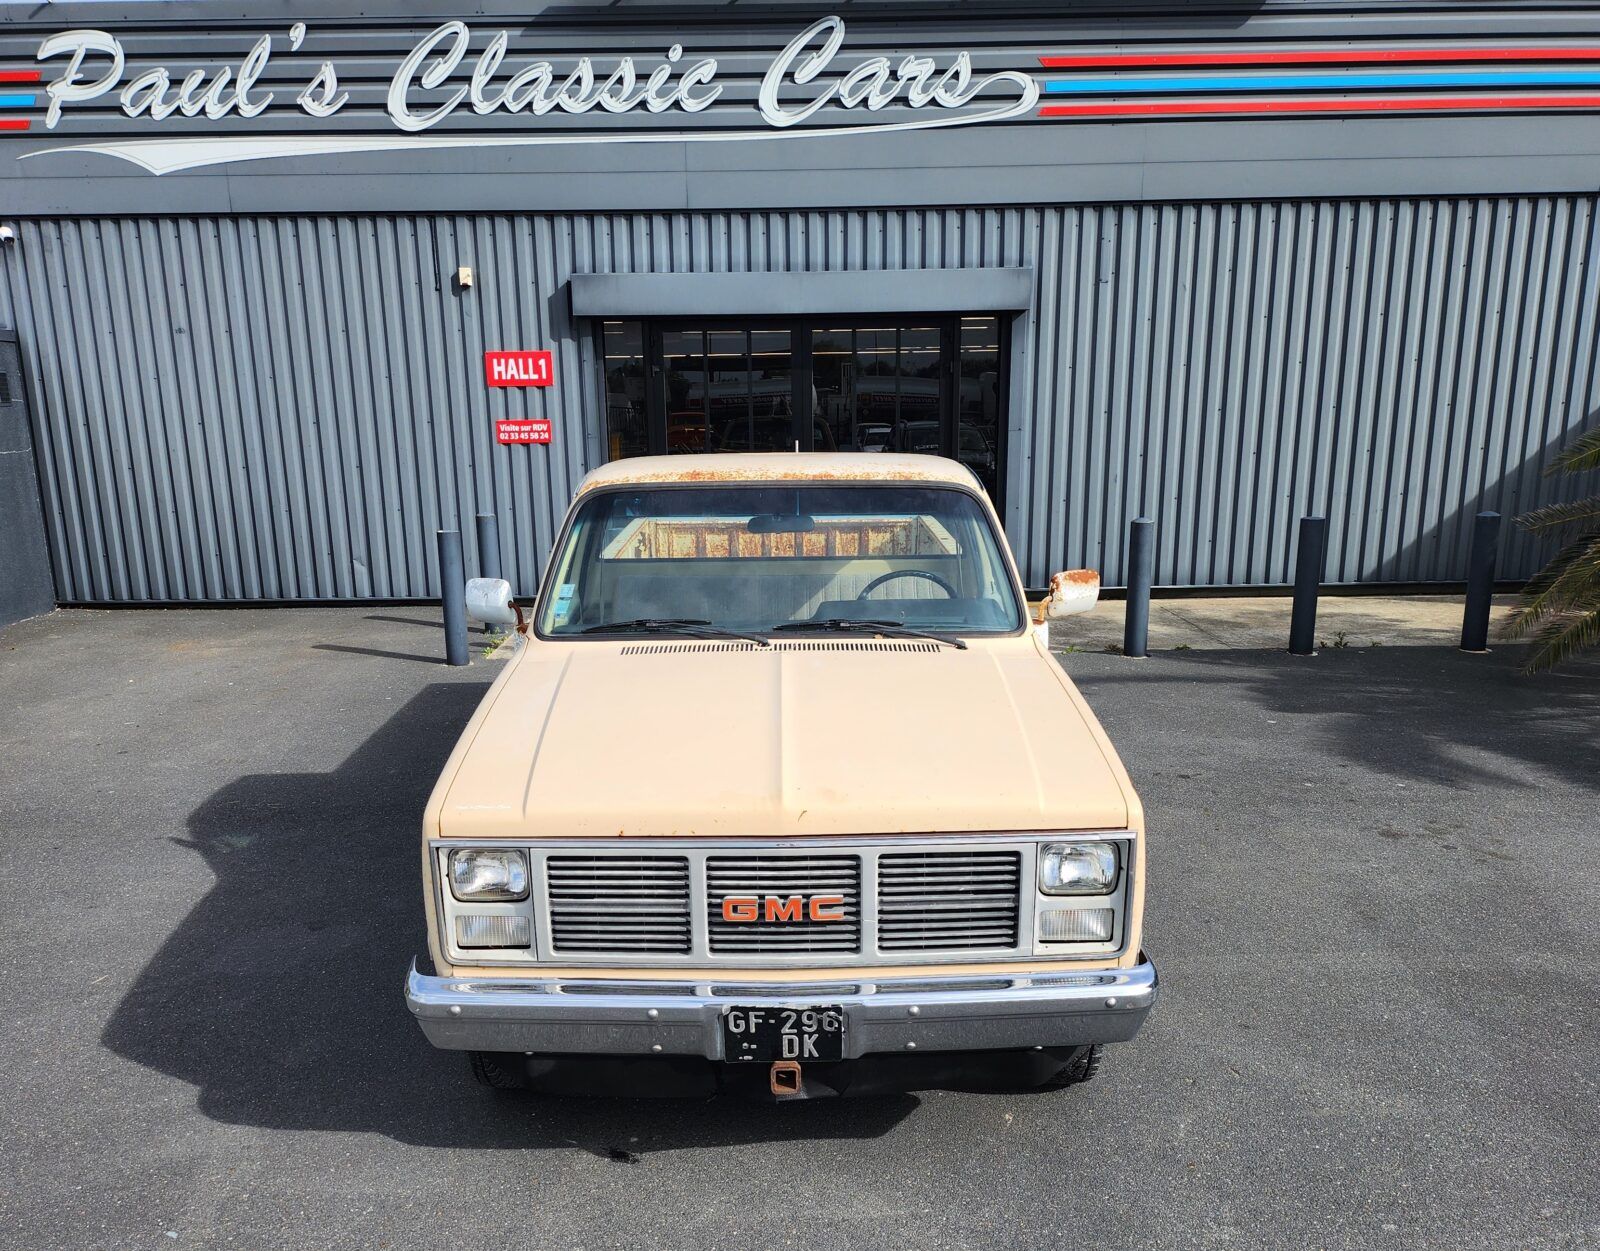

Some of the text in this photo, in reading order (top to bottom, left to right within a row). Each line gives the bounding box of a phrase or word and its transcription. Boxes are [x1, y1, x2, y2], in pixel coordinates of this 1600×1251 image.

[37, 15, 1039, 131] Paul's Classic Cars
[499, 423, 548, 432] Visite sur RDV
[499, 432, 509, 440] 02
[510, 432, 519, 440] 33
[520, 432, 529, 440] 45
[540, 432, 549, 440] 24
[722, 894, 844, 922] GMC
